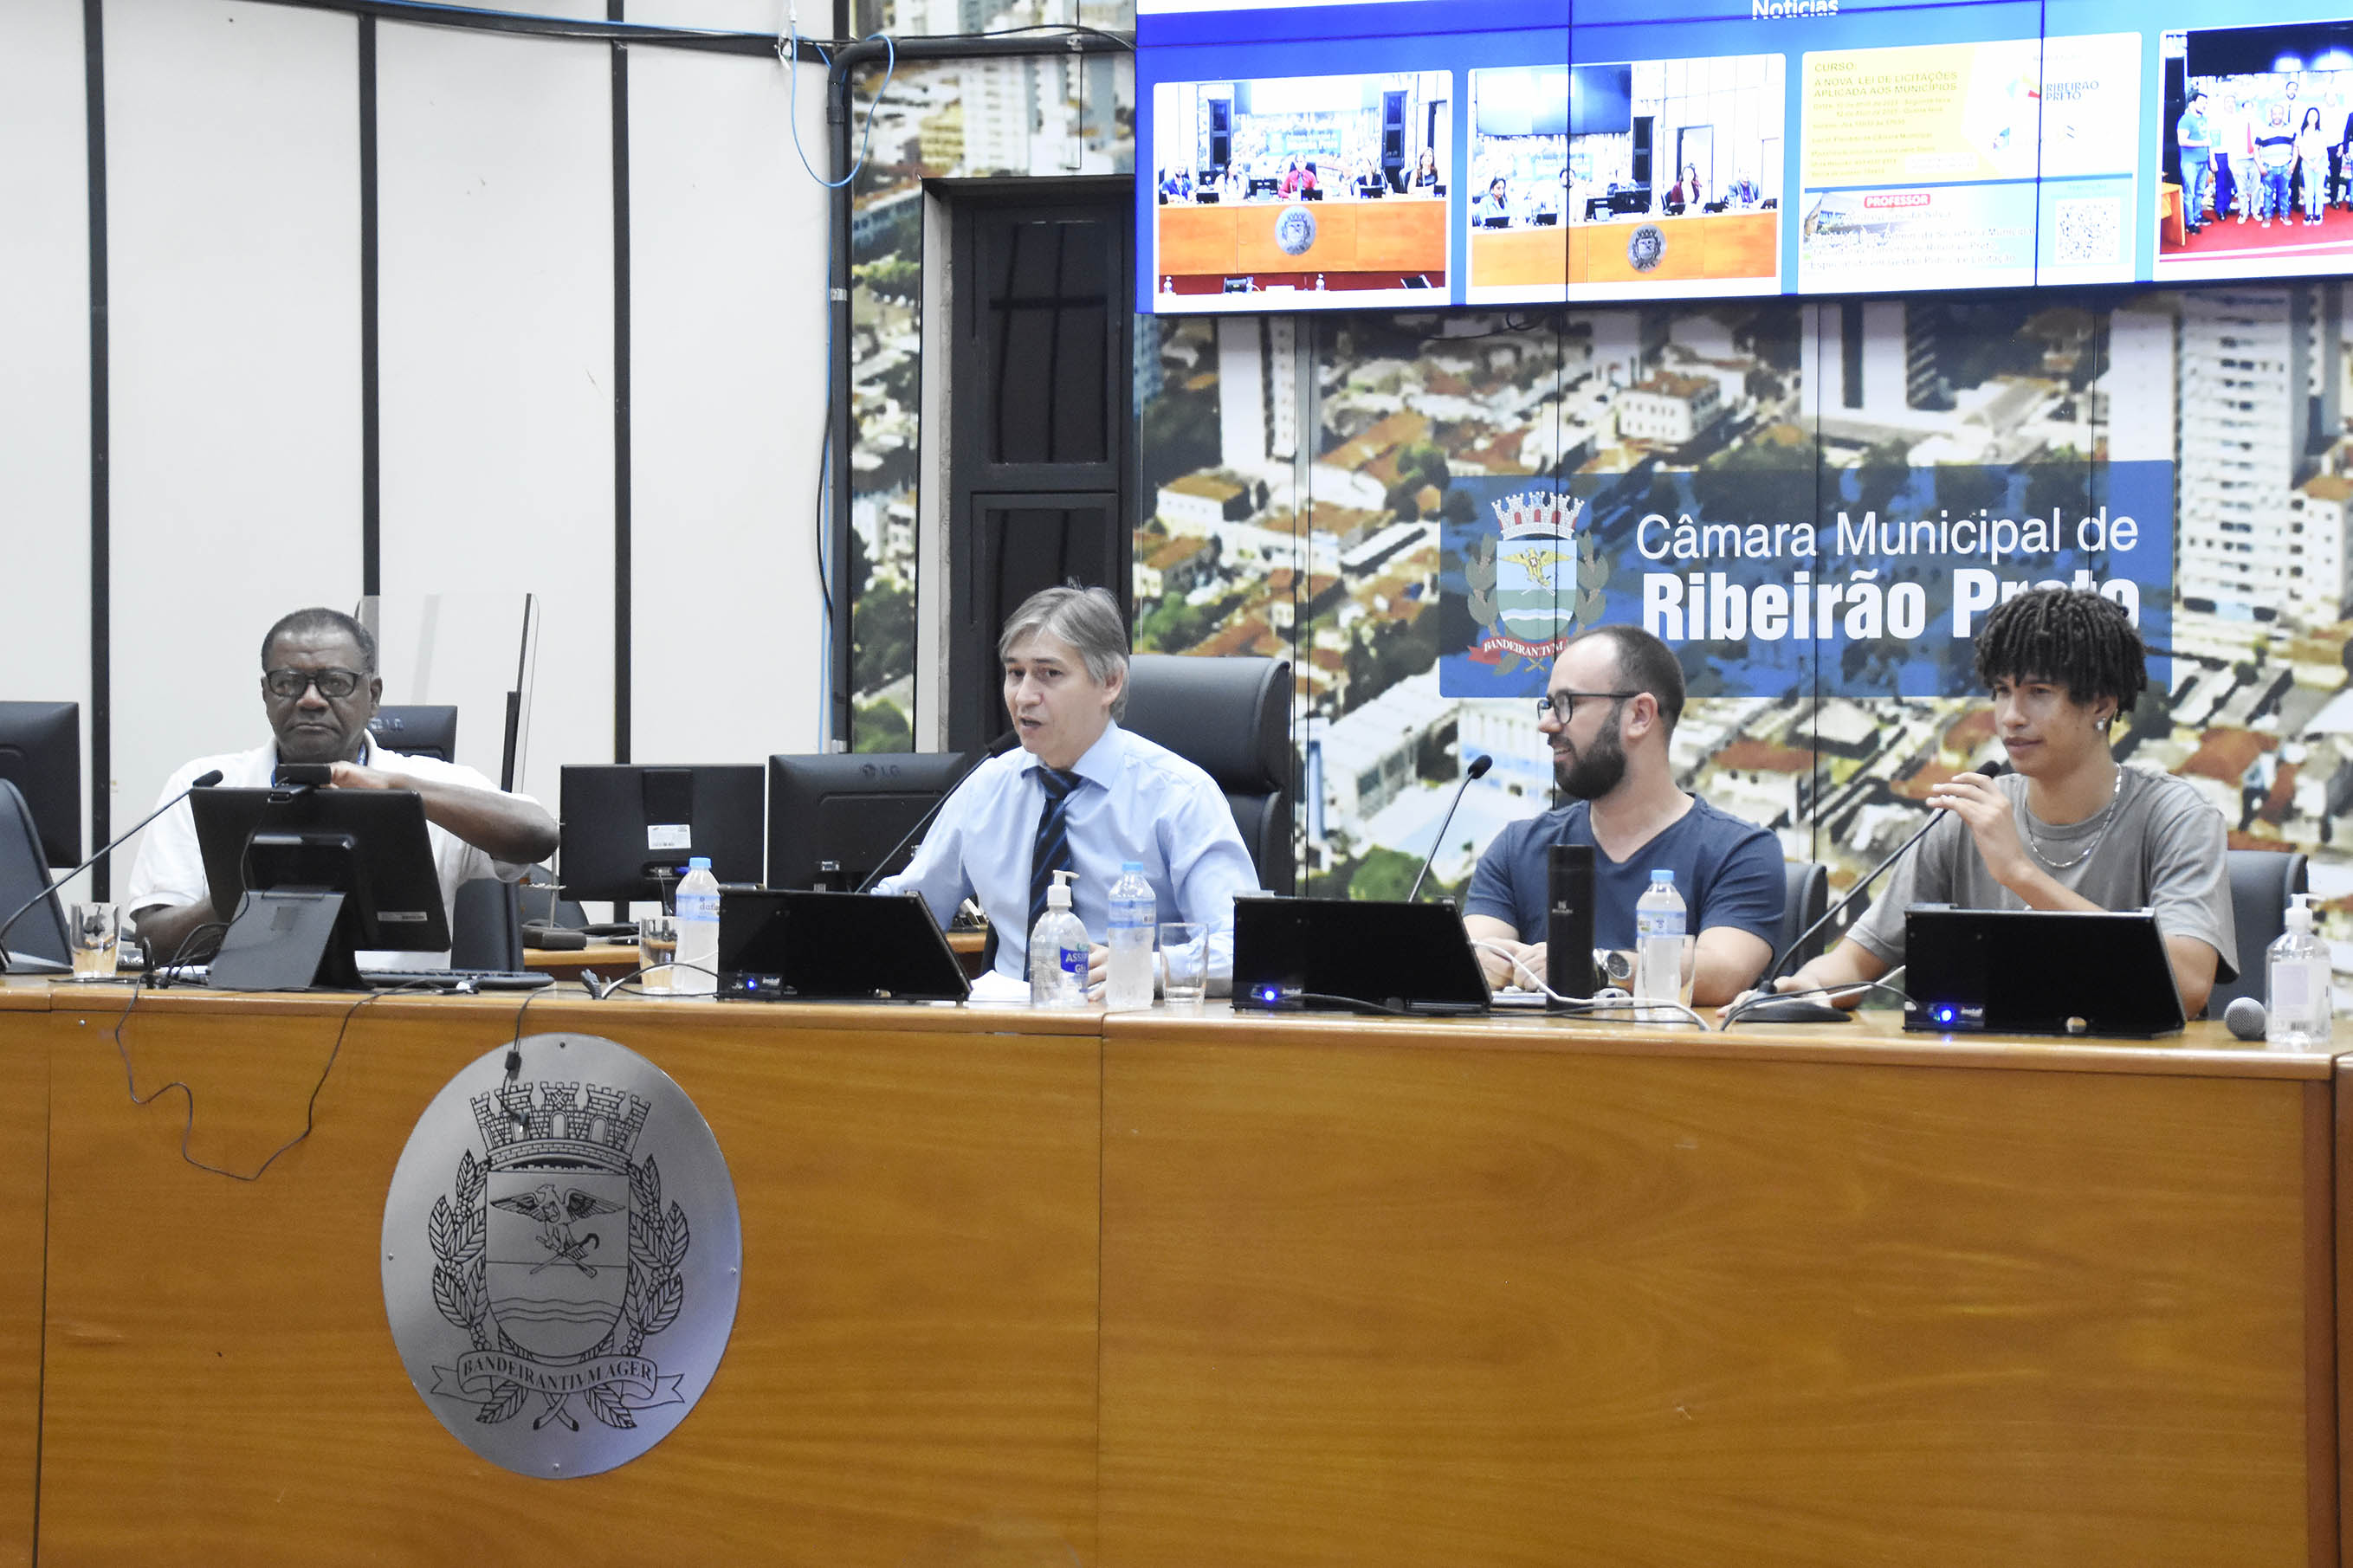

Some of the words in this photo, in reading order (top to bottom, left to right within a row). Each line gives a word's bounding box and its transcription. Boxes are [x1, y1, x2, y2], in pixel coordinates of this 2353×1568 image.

[1814, 87, 1866, 97] APLICADA
[1870, 86, 1891, 95] AOS
[1824, 76, 1853, 87] NOVA
[1858, 75, 1874, 85] LEI
[1878, 74, 1891, 84] DE
[1866, 195, 1929, 207] PROFESSOR
[1636, 513, 1817, 560] Câmara
[1836, 507, 2060, 565] Municipal
[2076, 506, 2139, 552] de
[1643, 568, 1926, 641] Ribeirão
[463, 1356, 601, 1391] BANDEIRANTIVM
[607, 1358, 652, 1382] AGER
